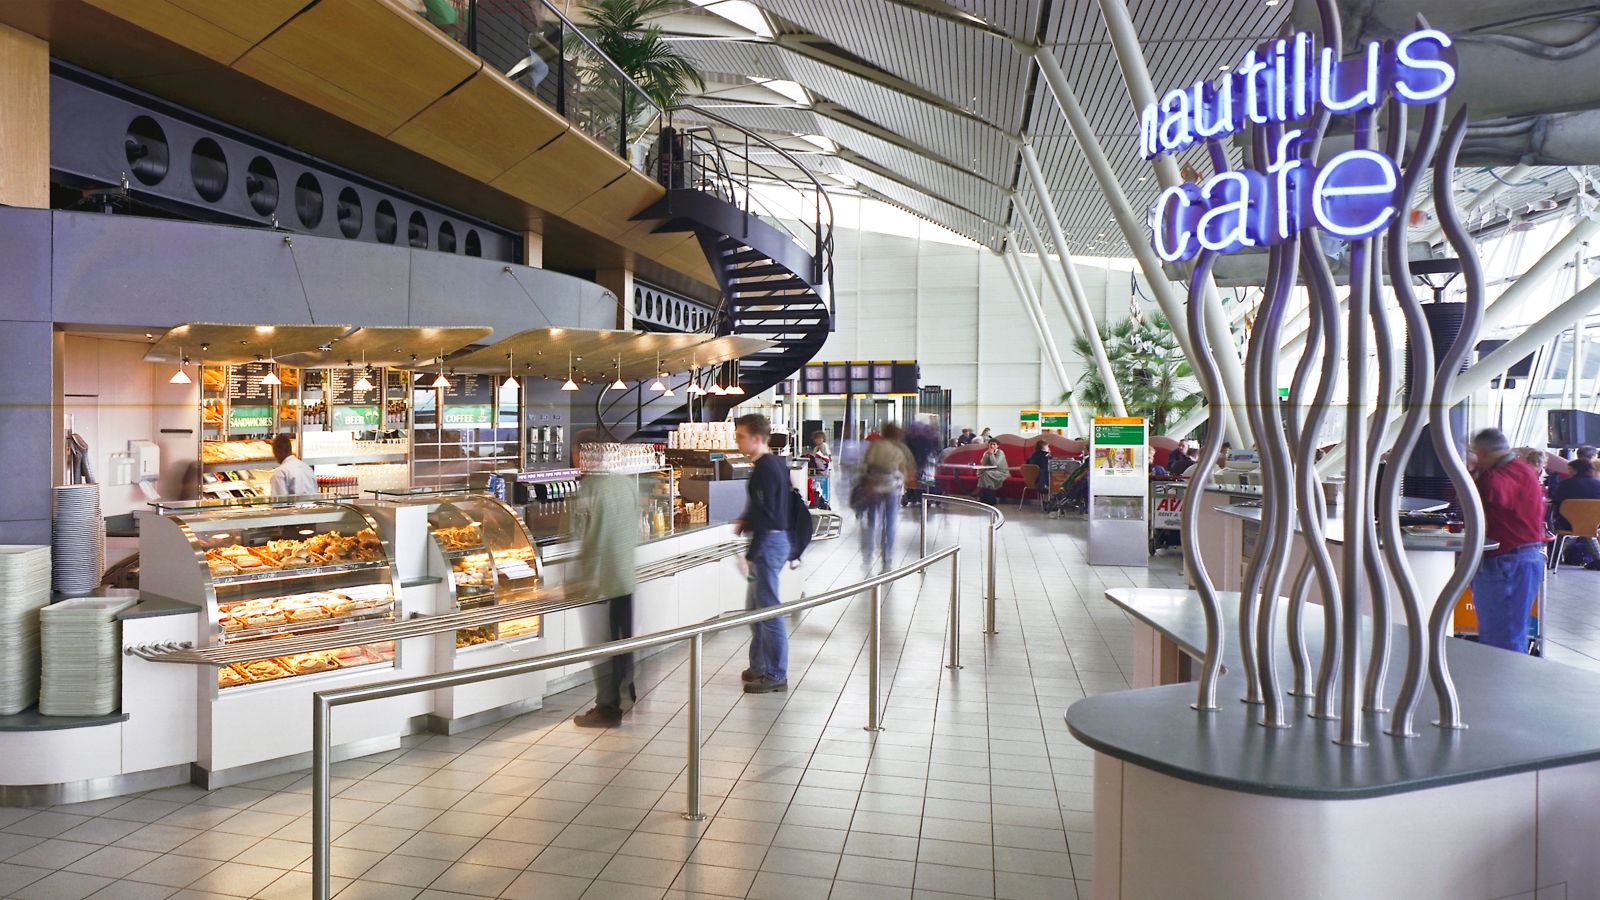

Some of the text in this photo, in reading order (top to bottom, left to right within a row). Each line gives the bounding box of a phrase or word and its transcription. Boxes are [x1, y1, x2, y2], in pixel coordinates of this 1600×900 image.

[1139, 28, 1457, 161] nautilus
[1153, 128, 1398, 263] cafe
[230, 416, 273, 428] SANDWICHES
[344, 415, 365, 425] BEER
[445, 414, 475, 423] COFFEE
